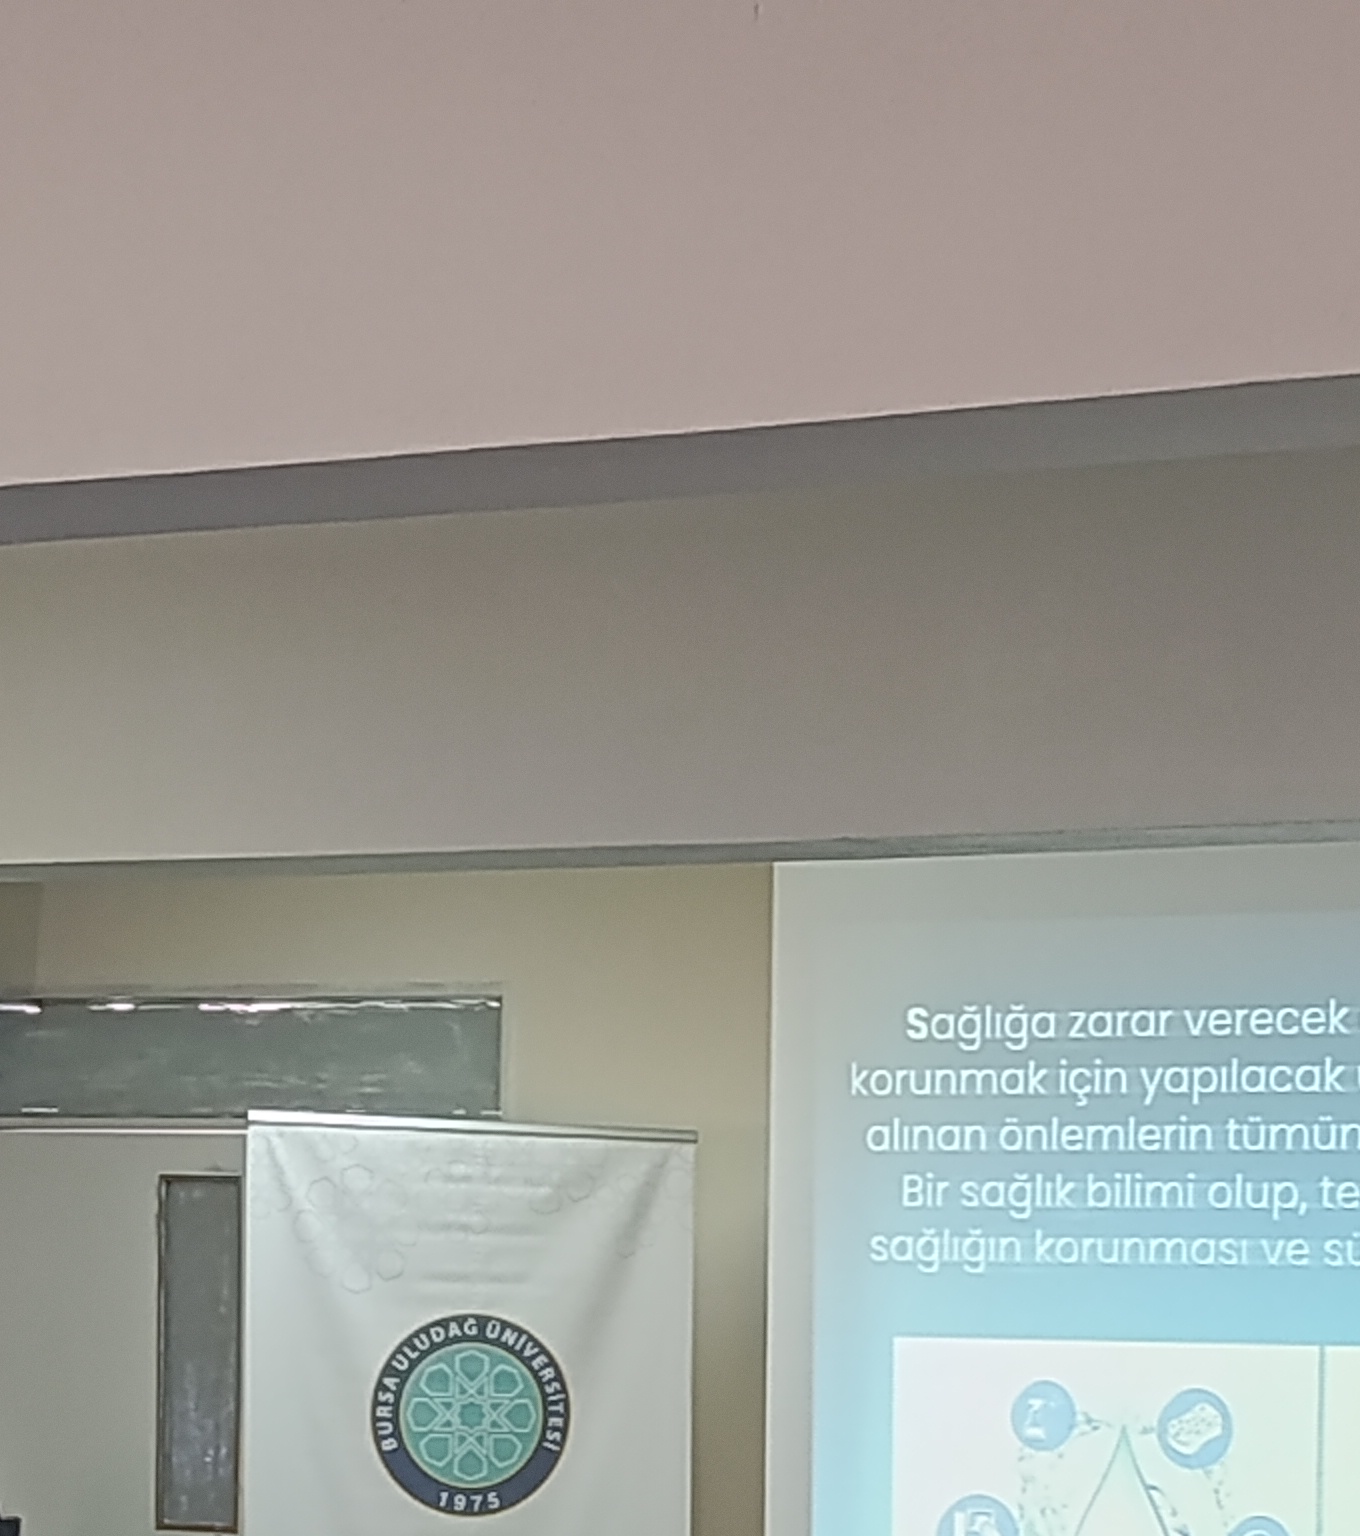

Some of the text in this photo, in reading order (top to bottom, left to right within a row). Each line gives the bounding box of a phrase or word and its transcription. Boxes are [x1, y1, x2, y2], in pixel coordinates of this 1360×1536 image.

[906, 1003, 1056, 1051] Sağlığa
[1068, 1008, 1174, 1038] zarar
[1184, 998, 1351, 1037] verecek
[851, 1060, 1048, 1096] korunmak
[1059, 1058, 1128, 1106] için
[1140, 1057, 1345, 1105] yapılacak
[866, 1118, 987, 1151] alınan
[999, 1115, 1213, 1151] önlemlerin
[901, 1172, 949, 1208] Bir
[960, 1173, 1076, 1219] sağlık
[1087, 1173, 1195, 1208] bilimi
[1207, 1174, 1308, 1220] olup,
[869, 1228, 1022, 1273] sağlığın
[1035, 1229, 1248, 1265] korunması
[1262, 1238, 1310, 1265] ve
[376, 1318, 566, 1451] BURSA ULUDAĞ ÜNİVERSİTESİ
[439, 1491, 500, 1512] 1975
